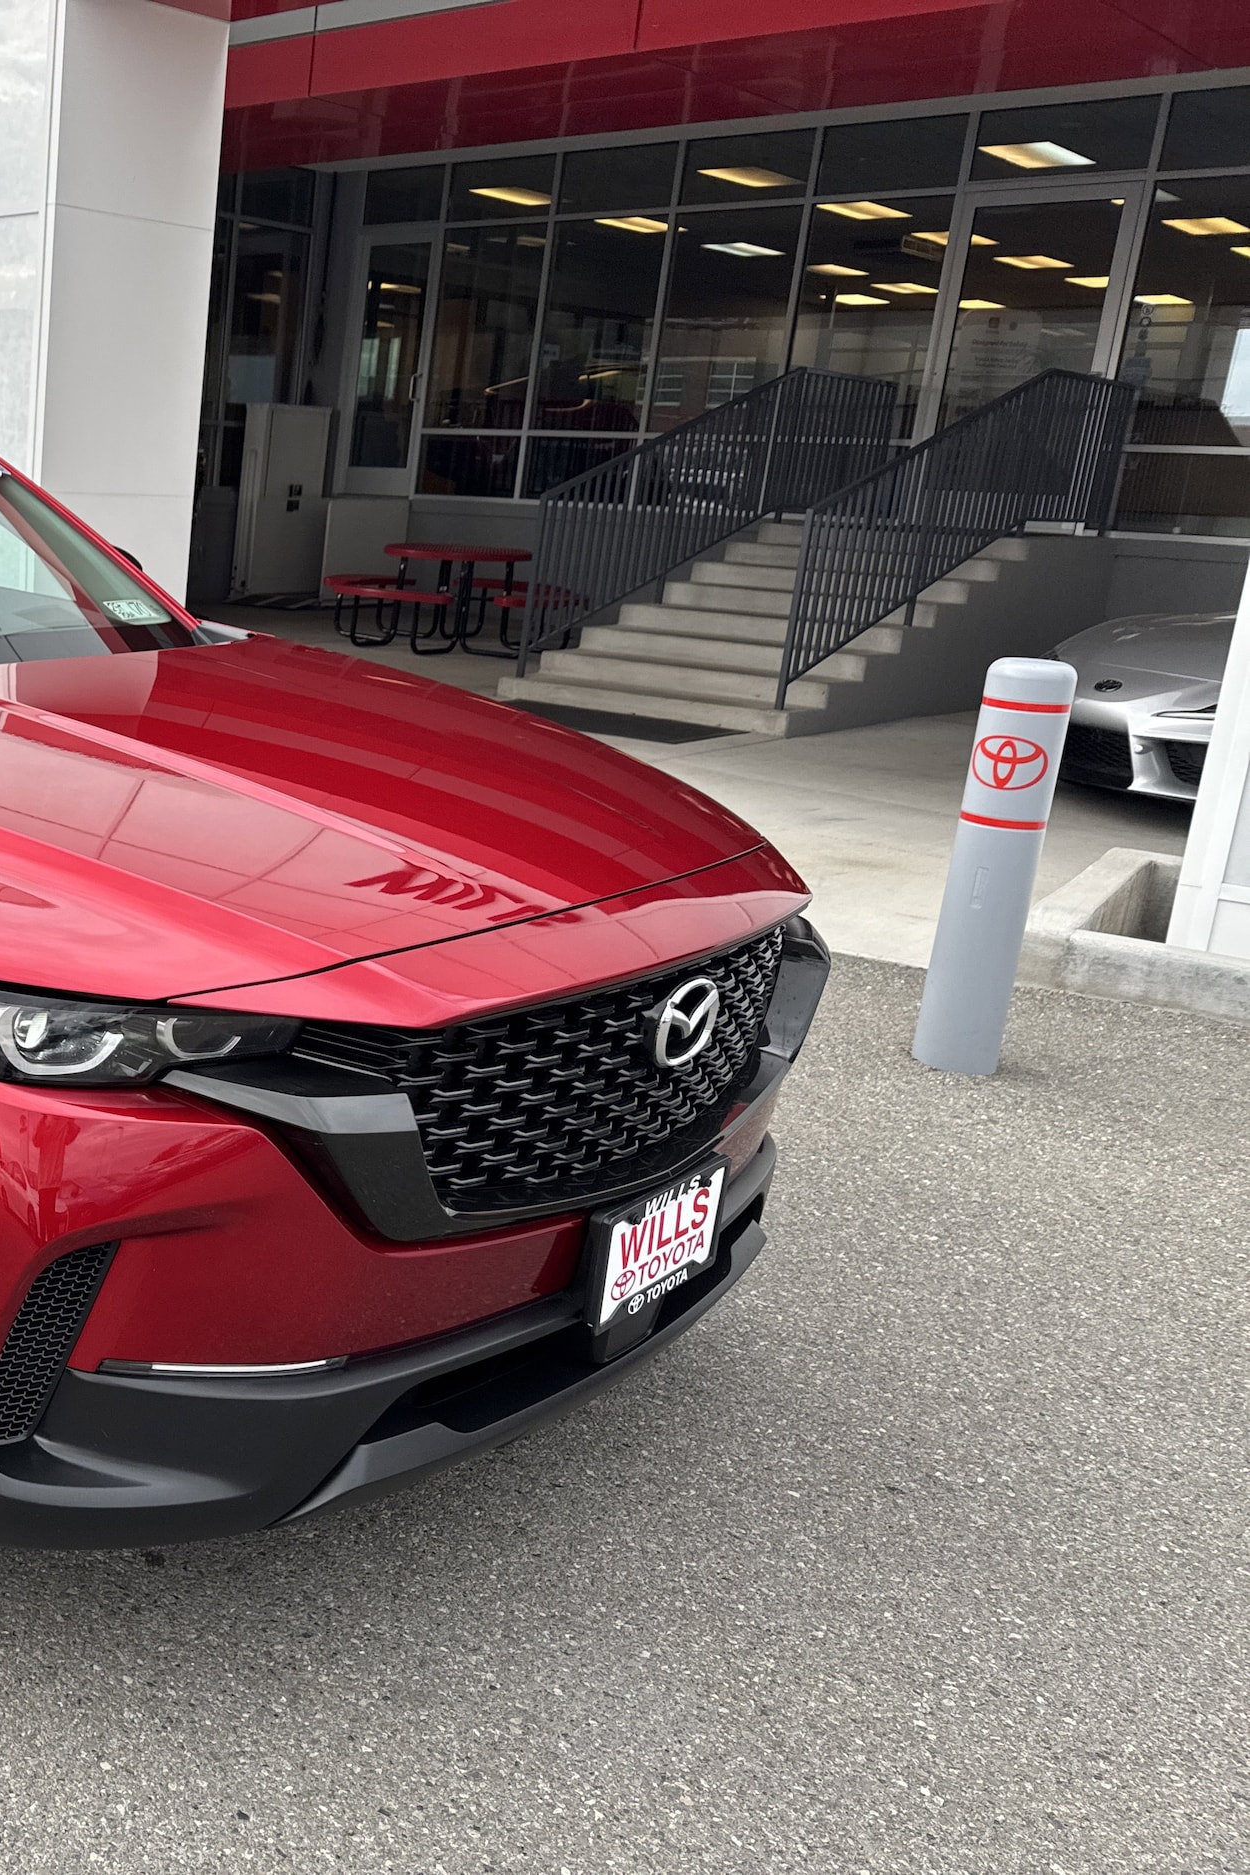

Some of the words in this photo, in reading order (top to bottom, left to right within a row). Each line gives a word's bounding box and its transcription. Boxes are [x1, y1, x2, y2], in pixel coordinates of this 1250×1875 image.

[645, 1174, 701, 1215] WILLS
[621, 1188, 710, 1269] WILLS
[638, 1231, 704, 1285] TOYOTA
[646, 1269, 688, 1302] TOYOTA
